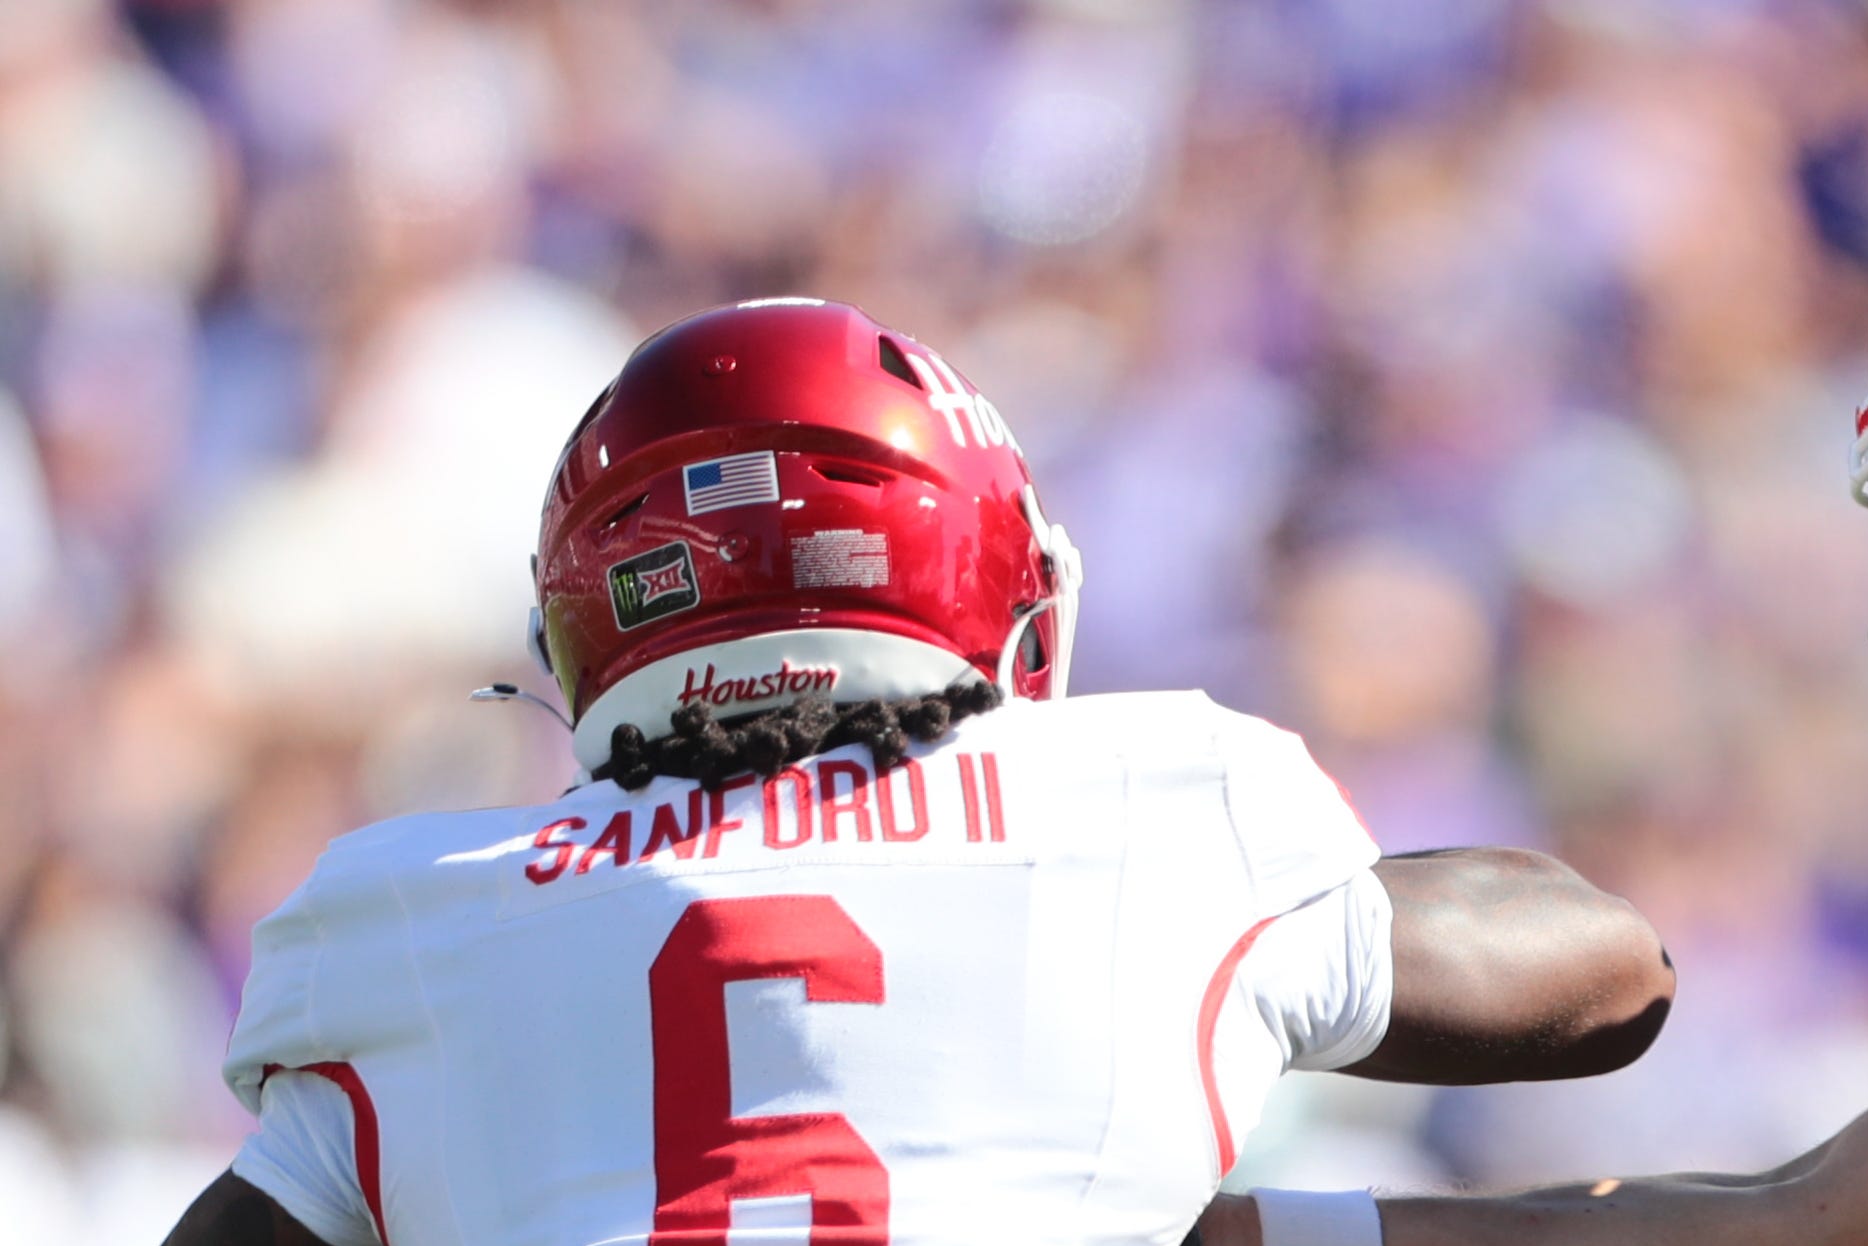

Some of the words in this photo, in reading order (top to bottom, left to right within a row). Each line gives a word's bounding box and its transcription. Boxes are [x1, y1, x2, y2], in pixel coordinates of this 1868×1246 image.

[677, 660, 839, 706] Houston
[525, 756, 930, 885] SANFORD
[957, 752, 1006, 842] II
